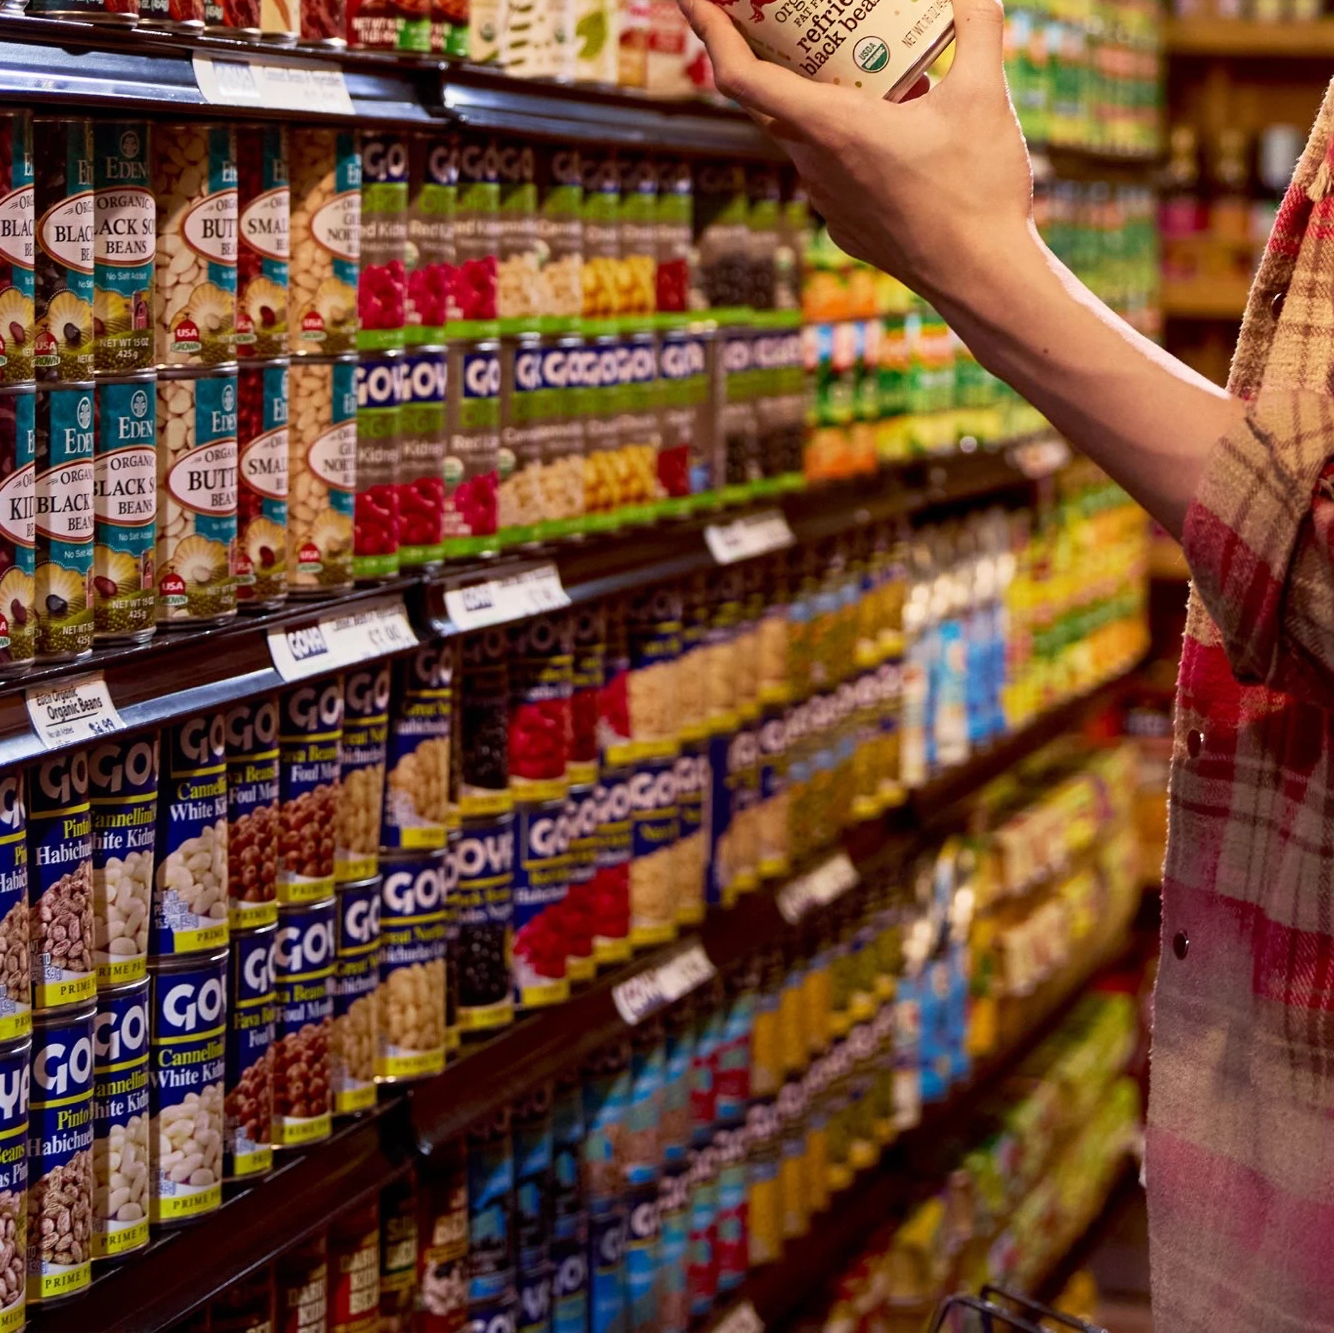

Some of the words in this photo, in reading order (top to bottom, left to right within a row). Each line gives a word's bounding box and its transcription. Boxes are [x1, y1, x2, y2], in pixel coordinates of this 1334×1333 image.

[793, 7, 813, 28] FAT
[901, 30, 917, 49] NET
[799, 30, 847, 77] black
[859, 42, 877, 61] USDA
[106, 241, 147, 254] BEANS
[106, 271, 116, 281] No
[101, 337, 117, 348] NET
[119, 337, 131, 347] WT
[177, 328, 197, 338] USA
[37, 494, 91, 513] BLACK
[119, 533, 127, 542] No
[64, 550, 73, 559] No
[162, 581, 183, 591] USA
[113, 599, 129, 609] NET
[130, 598, 142, 608] WT
[62, 624, 77, 635] NET
[51, 685, 79, 704] Organic
[47, 700, 80, 722] Organic
[78, 697, 103, 713] Beans
[170, 800, 214, 823] White
[163, 978, 221, 1032] GO
[33, 1036, 93, 1096] GO
[151, 1068, 199, 1090] White
[45, 1270, 82, 1290] PRIME
